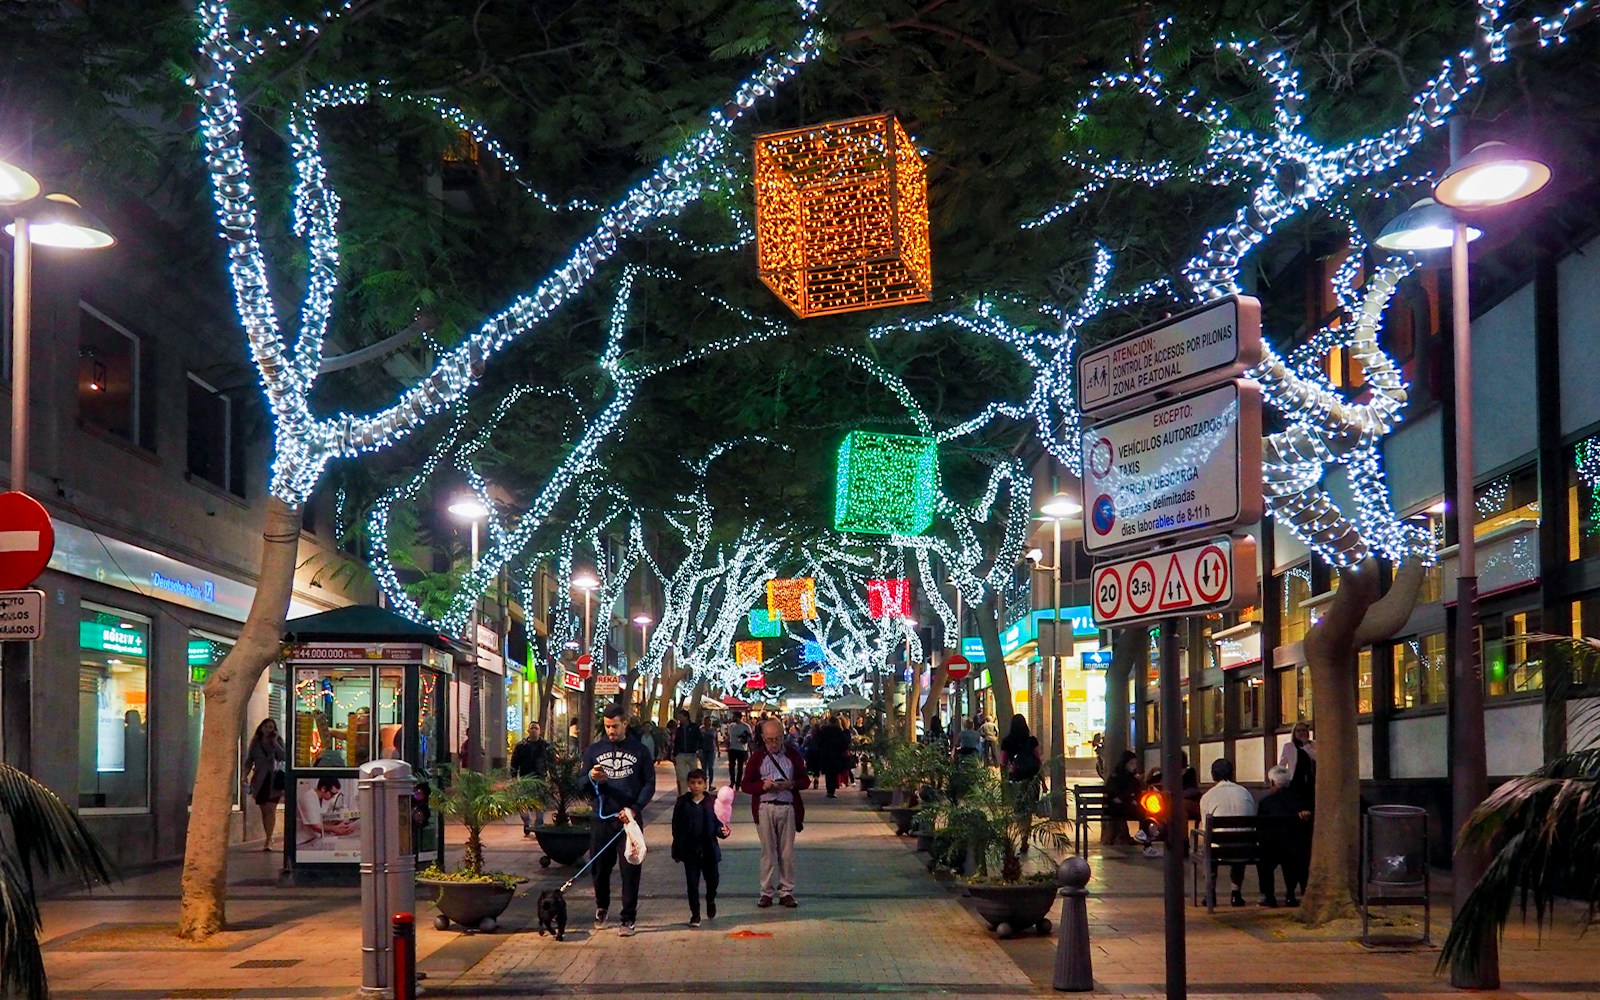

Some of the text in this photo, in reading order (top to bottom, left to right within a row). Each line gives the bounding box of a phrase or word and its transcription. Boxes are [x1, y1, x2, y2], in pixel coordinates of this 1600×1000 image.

[1112, 337, 1156, 363] ATENCIÓN:
[1112, 324, 1233, 380] CONTROL DE ACCESOS POR PILONAS
[1112, 363, 1182, 396] ZONA PEATONAL
[1153, 404, 1193, 428] EXCEPTO:
[1118, 435, 1162, 459] VEHÍCULOS
[1163, 417, 1222, 445] AUTORIZADOS
[1119, 460, 1141, 477] TAXIS
[1154, 466, 1199, 490] DESCARGA
[1152, 489, 1196, 511] delimitadas
[1137, 513, 1175, 534] laborables
[1176, 510, 1186, 525] de
[1187, 506, 1204, 522] 8-11
[1204, 505, 1211, 518] h
[154, 571, 203, 600] Deutsche Bank
[1100, 583, 1117, 603] 20
